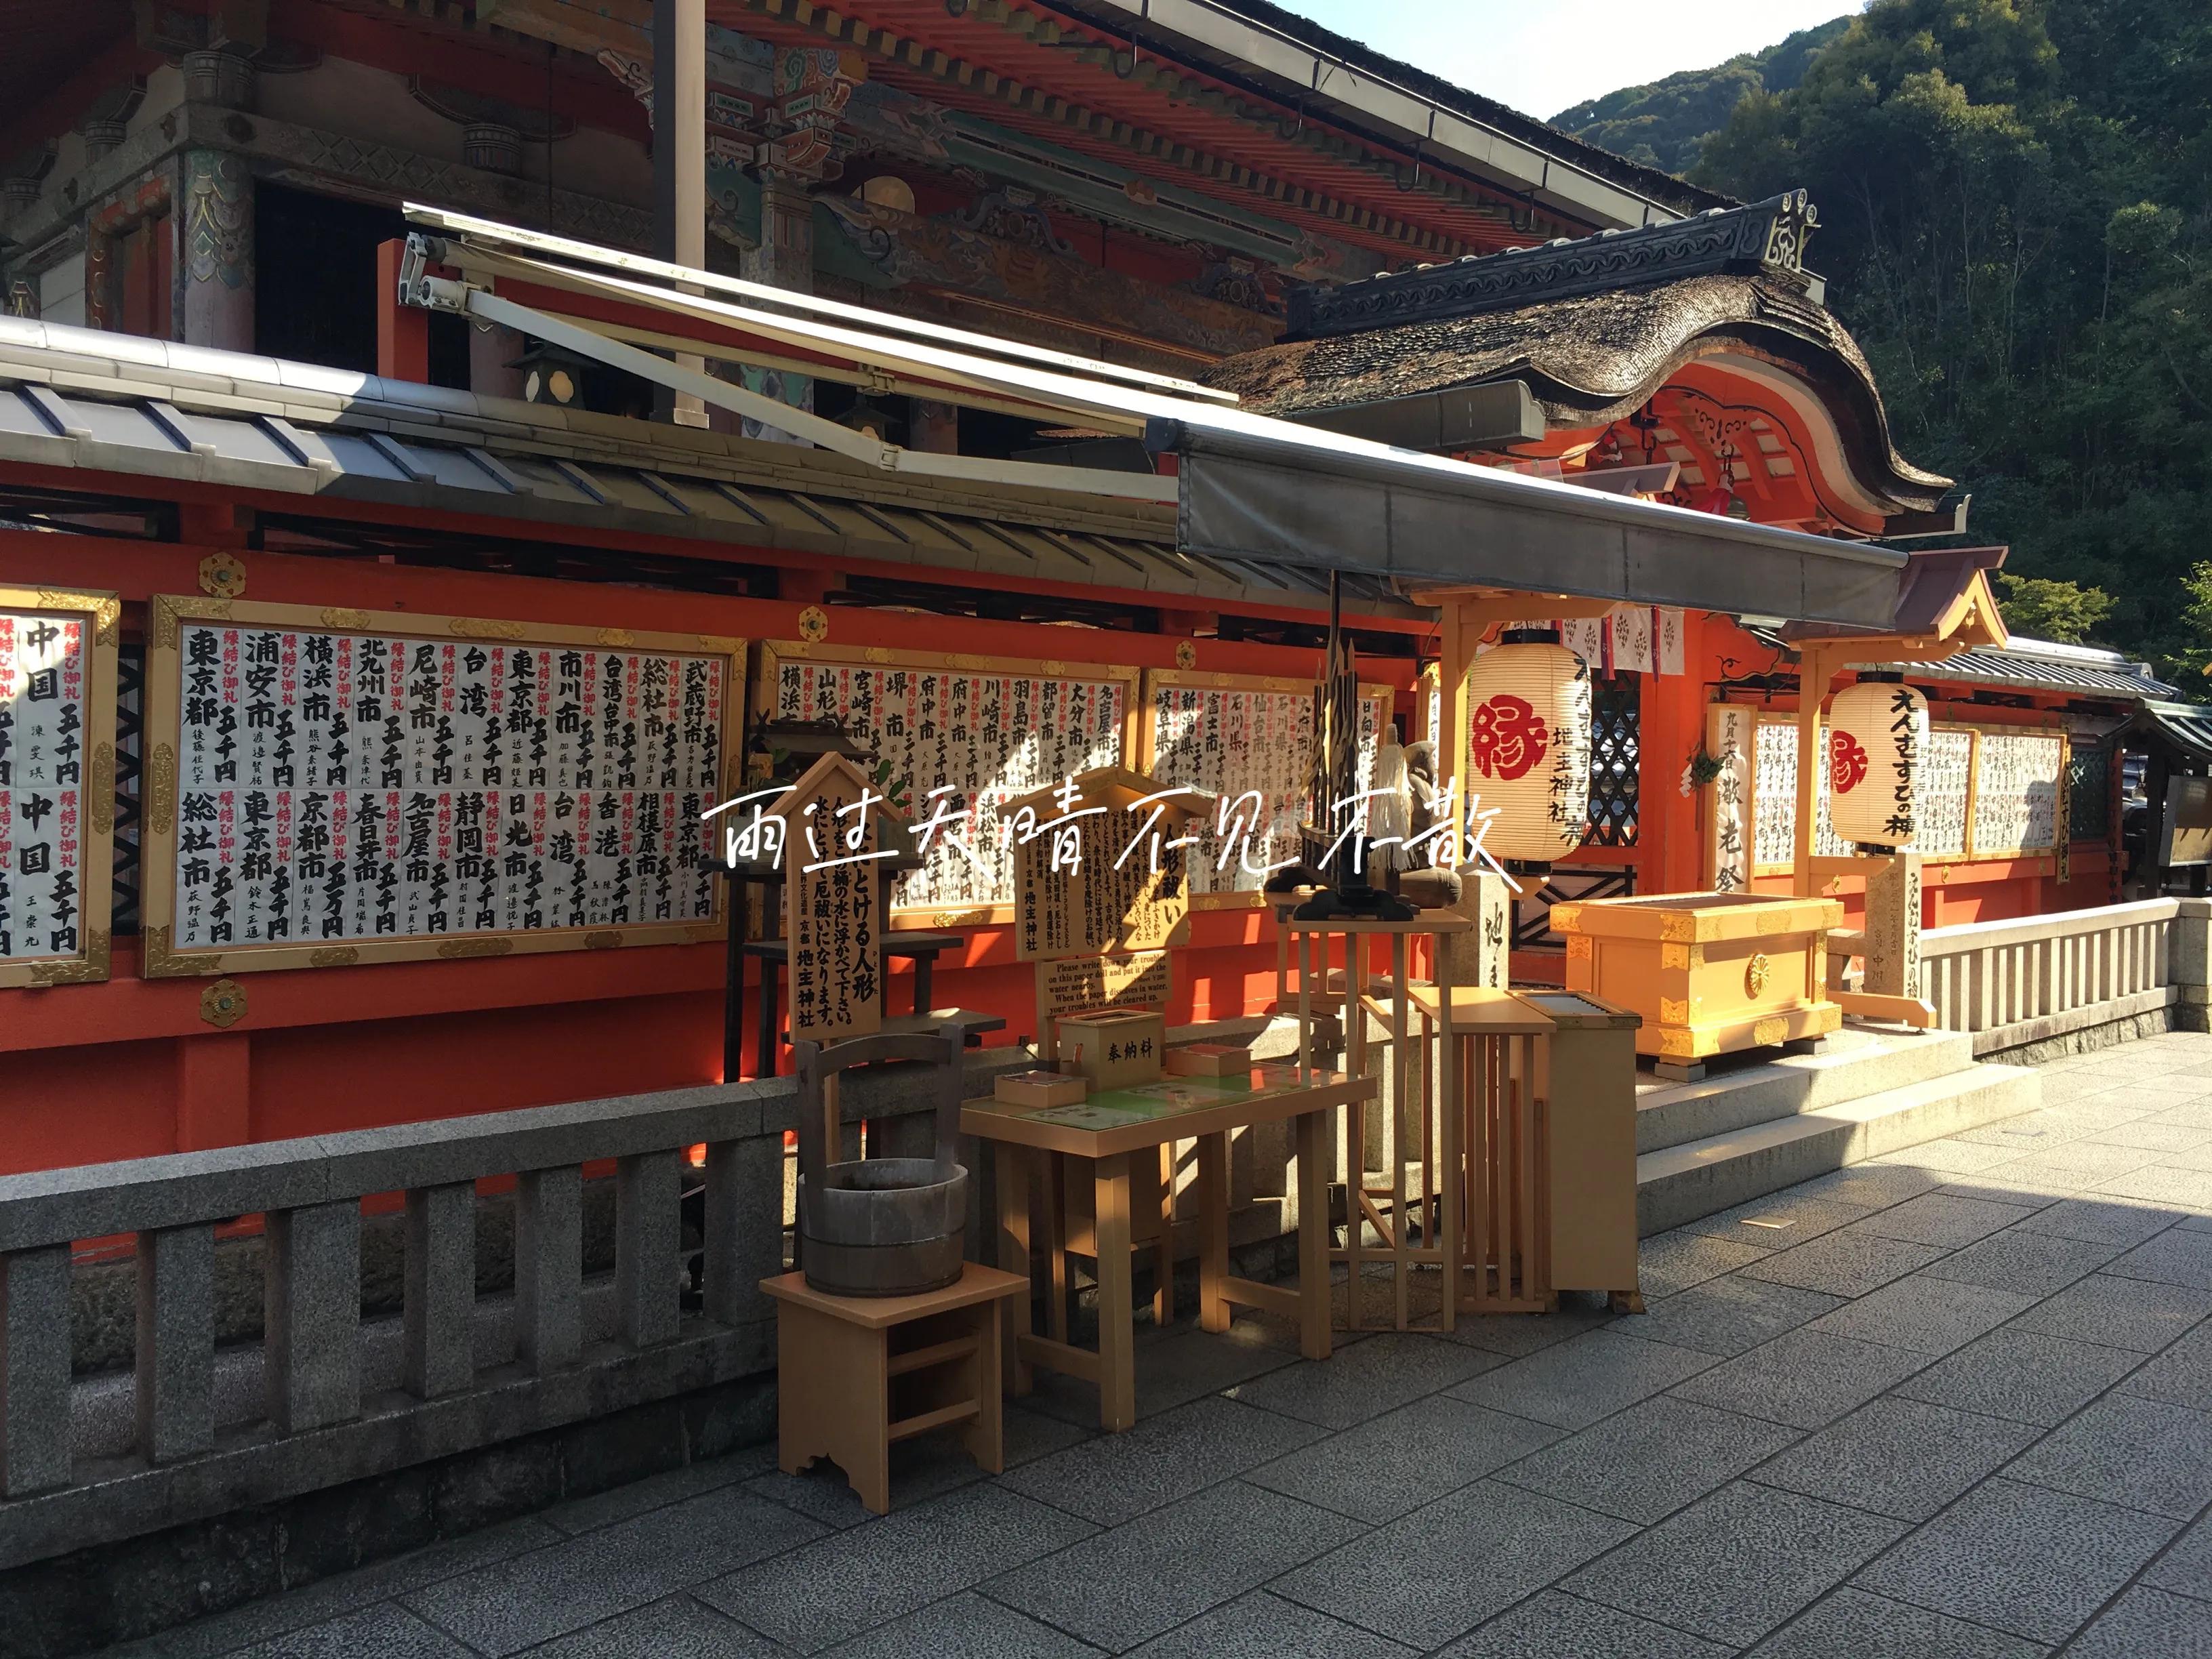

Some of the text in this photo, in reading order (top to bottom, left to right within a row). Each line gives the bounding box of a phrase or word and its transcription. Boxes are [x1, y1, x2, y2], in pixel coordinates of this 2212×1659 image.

[26, 621, 60, 702] 中国
[54, 623, 81, 785] 縁結び御礼 五千円
[182, 629, 222, 726] 東京都
[245, 632, 281, 729] 浦安市
[300, 635, 333, 722] 横浜市
[356, 639, 387, 722] 北九州市
[408, 644, 442, 729] 尼崎市
[460, 647, 489, 718] 台湾
[505, 649, 536, 733] 東京都
[555, 651, 581, 734] 市川市
[602, 654, 623, 748] 台湾台中市
[640, 658, 668, 737] 総社市
[684, 660, 708, 743] 武蔵野市
[214, 630, 239, 783] 縁結び御礼 五千円
[272, 634, 297, 787] 縁結び御礼 五千円
[326, 638, 352, 786] 縁結び御礼 五千円
[380, 642, 405, 789] 縁結び御礼 五千円
[432, 644, 456, 786] 縁結び御礼 五千円
[483, 647, 505, 786] 縁結び御礼 五千円
[529, 651, 551, 787] 縁結び御礼 五千円
[576, 653, 596, 789] 縁結び御礼 五千円
[617, 657, 639, 789] 縁結び御礼 五千円
[661, 660, 680, 788] 縁結び御礼 五千円
[701, 661, 720, 788] 縁結び御礼 五千円
[851, 670, 874, 739] 宮崎市
[886, 672, 908, 737] 堺市
[919, 675, 937, 741] 府中市
[951, 678, 968, 742] 府中市
[982, 680, 1000, 743] 川崎市
[1012, 679, 1029, 745] 羽島市
[1068, 683, 1087, 746] 大分市
[1097, 685, 1113, 751] 名古屋市
[1155, 690, 1172, 752] 岐阜県
[1179, 690, 1196, 756] 新潟県
[1206, 692, 1220, 753] 富士市
[1229, 694, 1243, 752] 石川県
[1472, 695, 1549, 781] 縁
[901, 731, 916, 788] 三千円
[934, 732, 947, 788] 三千円
[1025, 734, 1038, 787] 三千円
[1548, 727, 1573, 823] 地主神社
[1882, 689, 1919, 838] えんむすびの神
[20, 792, 54, 876] 中国
[178, 792, 218, 888] 総社市
[238, 790, 274, 881] 東京都
[294, 792, 329, 880] 京都市
[351, 793, 386, 882] 春日井市
[401, 791, 436, 882] 名古屋市
[453, 791, 485, 880] 静岡市
[504, 793, 533, 877] 日光市
[550, 790, 576, 864] 台湾
[595, 792, 621, 857] 香港
[635, 792, 663, 876] 相模原市
[675, 792, 702, 869] 東京都
[977, 793, 996, 853] 浜松市
[1715, 712, 1745, 893] 九月十六日 敬老祭
[49, 791, 78, 952] 縁結び御礼 五千円
[210, 791, 234, 943] 縁結び御礼 五千円
[267, 791, 291, 941] 縁結び御礼 五千円
[321, 791, 347, 939] 縁結び御礼 五万円
[375, 792, 400, 935] 縁結び御礼 五千円
[428, 792, 451, 934] 縁結び御礼 五千円
[475, 791, 499, 930] 縁結び御礼 五千円
[523, 792, 547, 930] 縁結び御礼 五千円
[569, 792, 591, 927] 縁結び御礼 五千円
[611, 792, 634, 924] 縁結び御礼 五千円
[655, 792, 676, 920] 縁結び御礼 五千円
[800, 920, 810, 945] 京都
[1025, 892, 1038, 951] 地主神社
[1057, 964, 1078, 972] Please
[1082, 960, 1100, 969] write
[1103, 959, 1120, 967] down
[1141, 954, 1166, 963] troubles
[797, 949, 815, 1028] 地主神社
[1049, 1006, 1065, 1015] your
[1068, 1002, 1096, 1011] troubles
[1099, 998, 1112, 1008] will
[1123, 994, 1146, 1004] cleared
[1055, 994, 1074, 1002] When
[1077, 992, 1086, 1000] the
[1089, 991, 1107, 1000] paper
[1059, 974, 1072, 982] this
[1074, 973, 1093, 982] paper
[1095, 969, 1107, 978] doll
[1124, 967, 1133, 976] put
[1156, 963, 1166, 971] the
[1107, 1037, 1152, 1064] 奉納料
